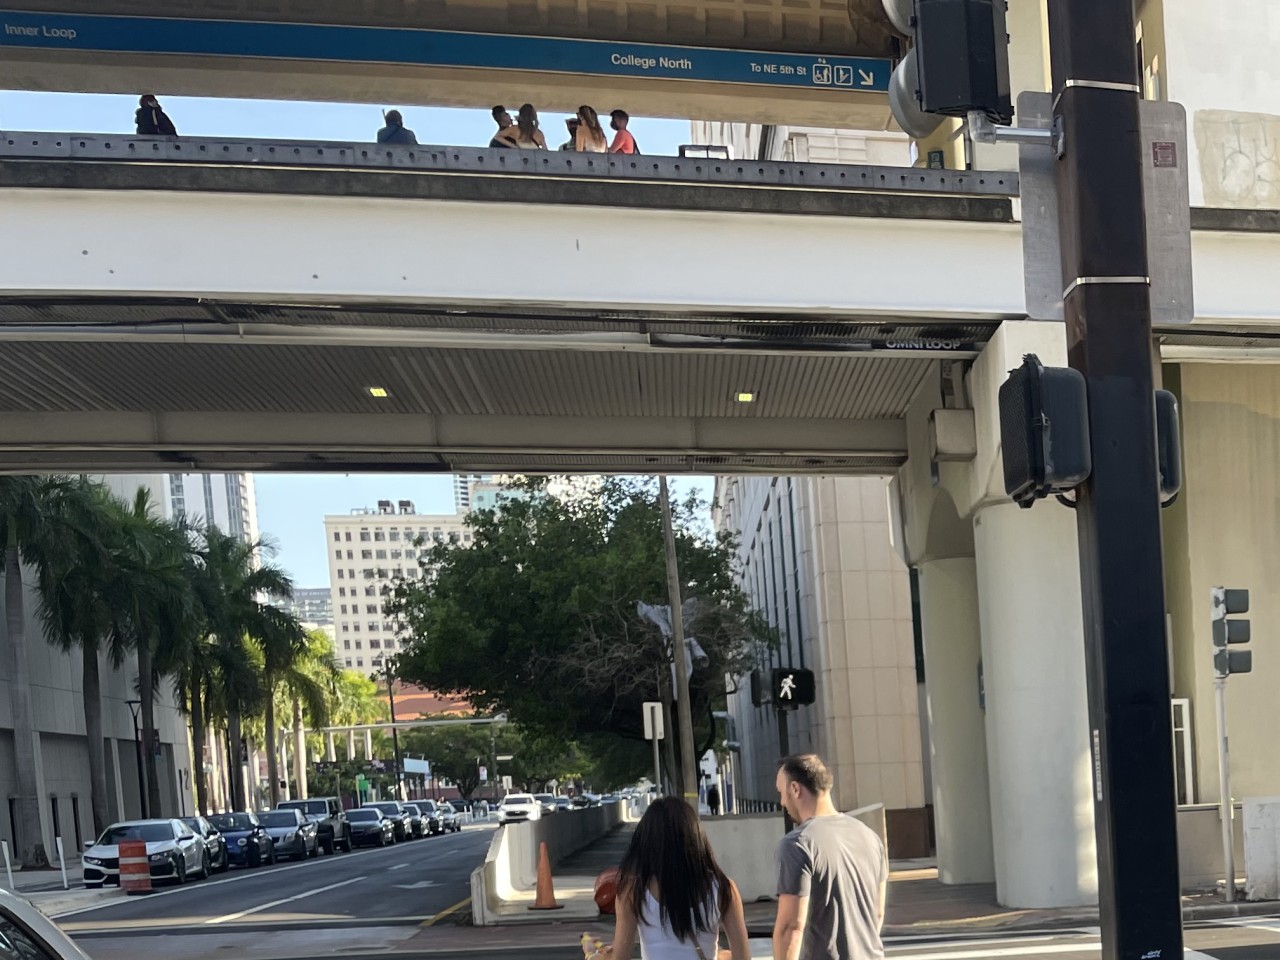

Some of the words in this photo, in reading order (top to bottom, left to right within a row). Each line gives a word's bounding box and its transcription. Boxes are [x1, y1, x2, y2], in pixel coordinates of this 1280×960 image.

[4, 23, 39, 36] Inner
[42, 25, 77, 40] Loop
[611, 53, 656, 69] College
[659, 57, 692, 70] North
[749, 62, 761, 73] To
[764, 64, 778, 75] NE
[779, 65, 797, 76] 5th
[796, 66, 807, 77] St
[886, 338, 925, 350] OMNI
[926, 340, 961, 350] LOOP
